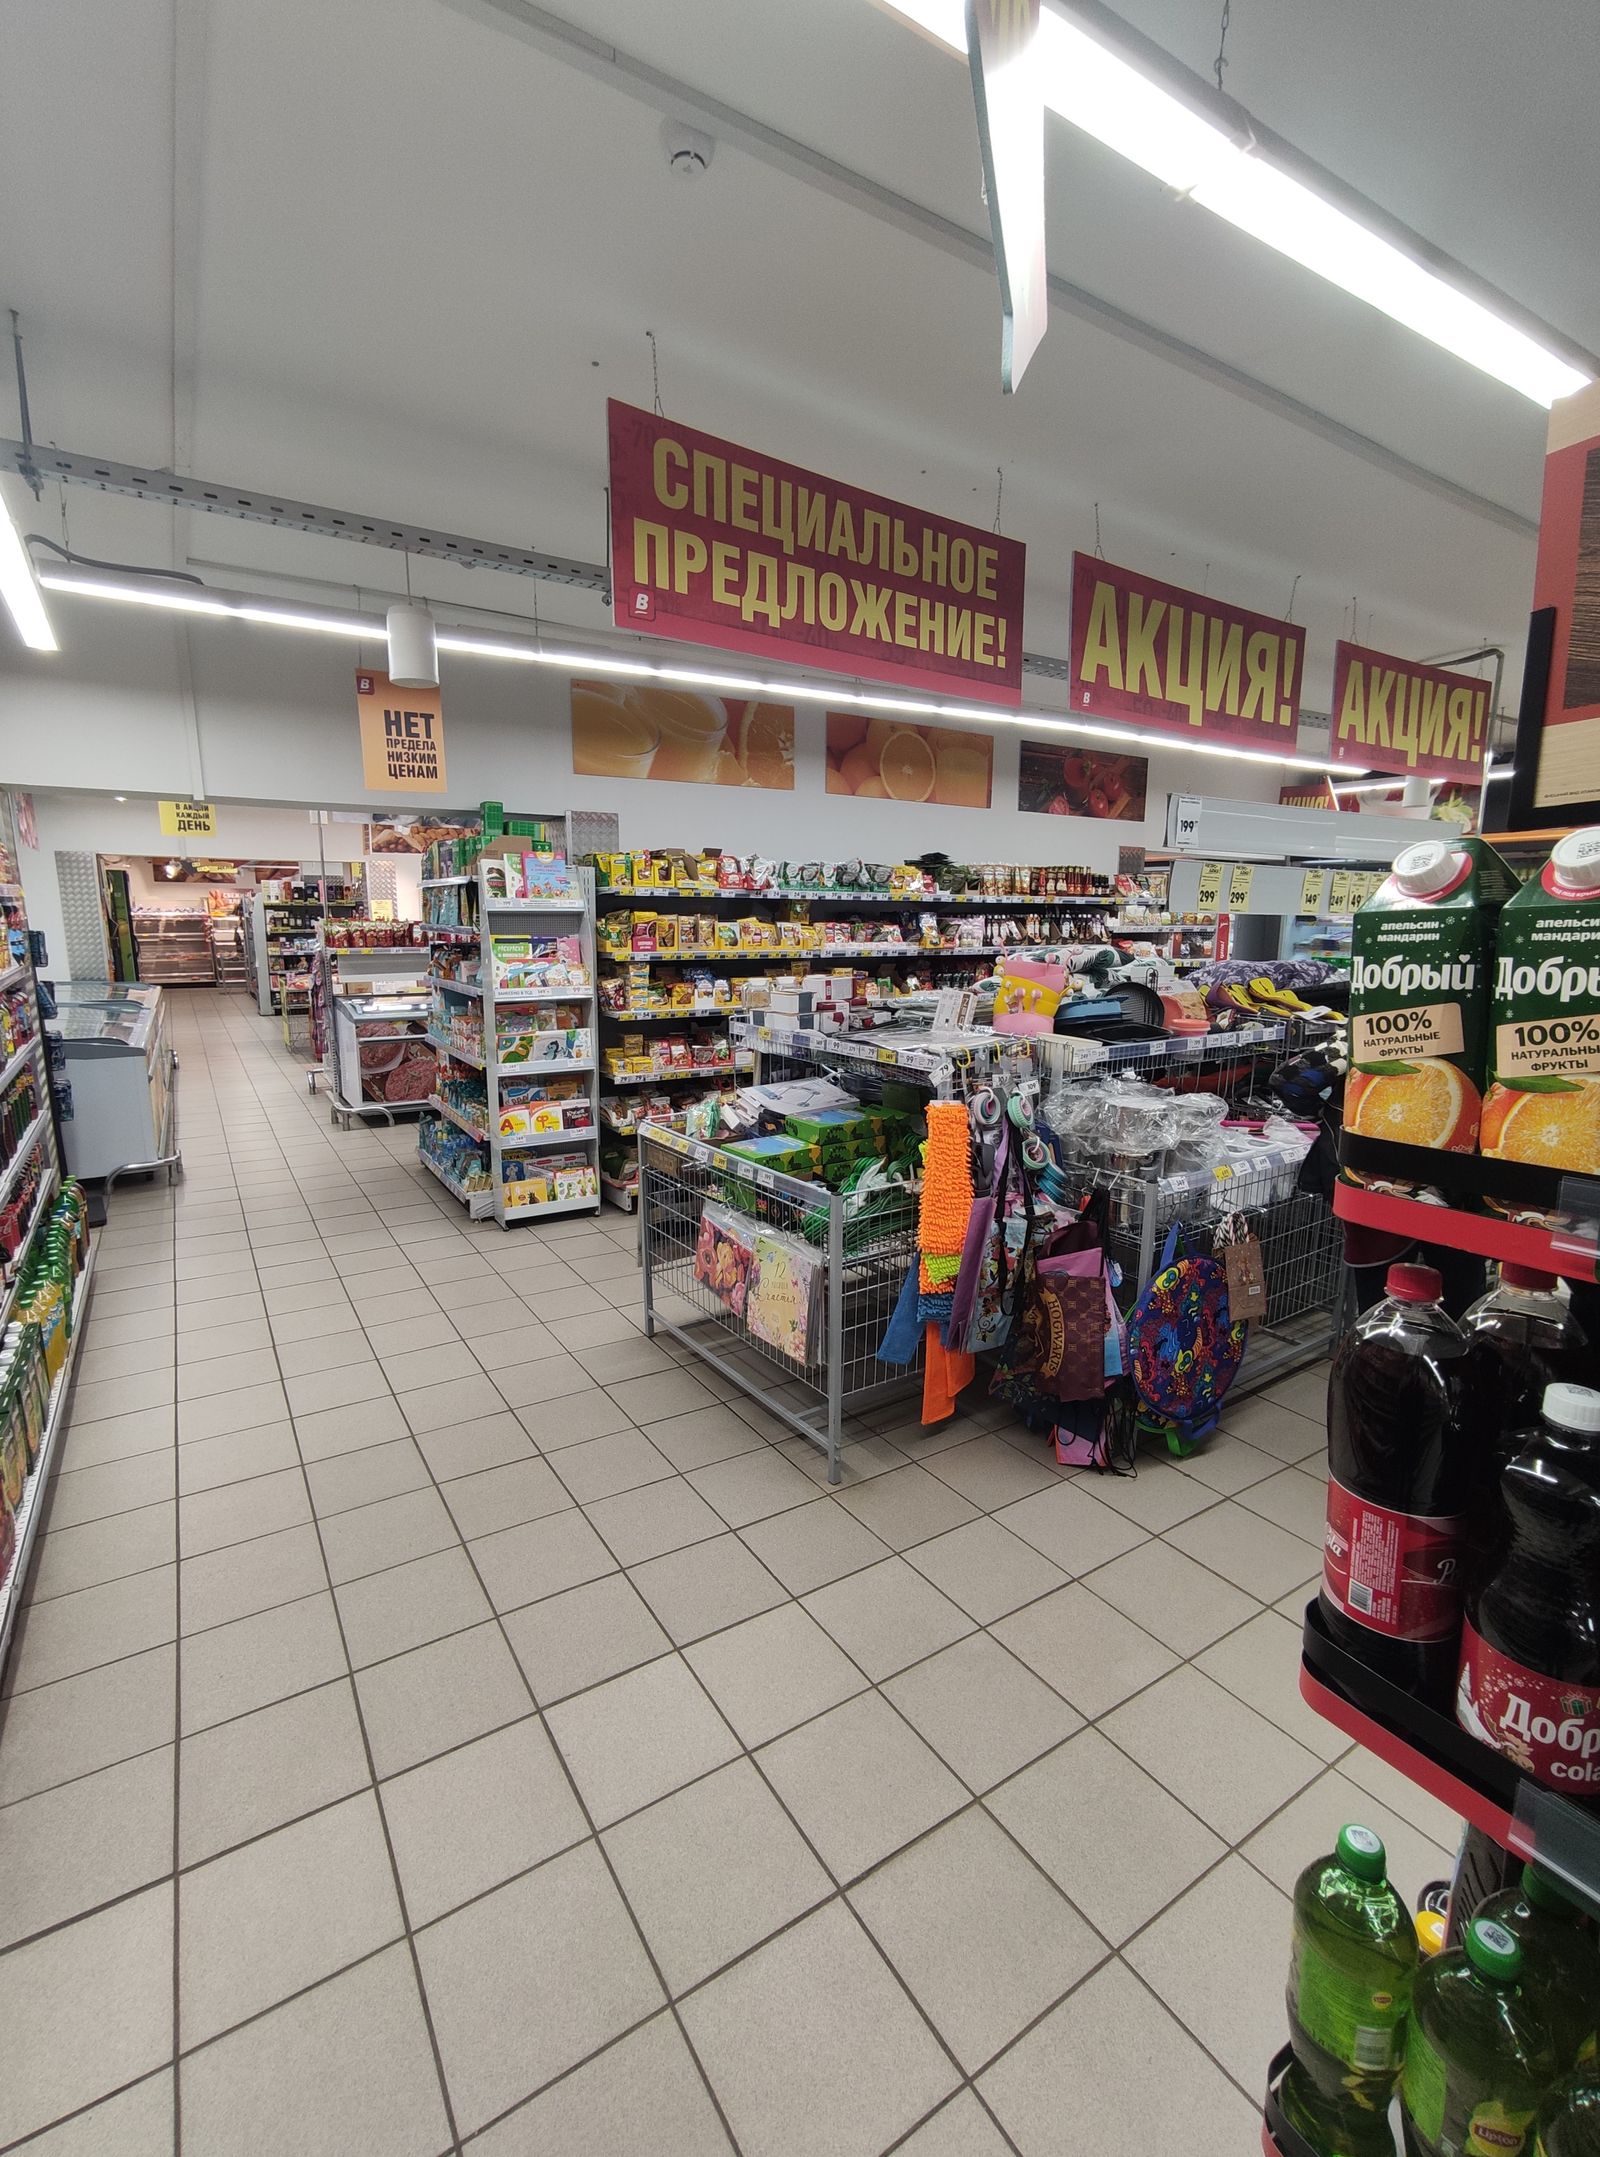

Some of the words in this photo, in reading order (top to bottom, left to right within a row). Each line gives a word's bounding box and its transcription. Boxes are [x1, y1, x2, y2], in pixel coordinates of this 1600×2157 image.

[652, 438, 999, 601] СПЕЦИАЛЬНОЕ
[633, 517, 1007, 669] ПРЕДЛОЖЕНИЕ!
[1079, 580, 1297, 727] АКЦИЯ!
[1338, 660, 1486, 767] АКЦИЯ!
[384, 710, 434, 739] НЕТ
[386, 738, 437, 752] ПРЕДЕЛА
[387, 751, 437, 765] НИЗКИМ
[388, 764, 438, 780] ЦЕНАМ
[176, 812, 209, 820] КАЖДЫЙ
[177, 820, 211, 832] ДЕНЬ
[1380, 921, 1440, 931] апельсин
[1535, 918, 1600, 928] апельси
[1377, 932, 1440, 943] мандарин
[1531, 930, 1600, 942] мандари
[1351, 954, 1476, 996] Добрый
[1366, 1009, 1432, 1036] 100%
[1363, 1031, 1440, 1048] НАТУРАЛЬНЫЕ
[1514, 1018, 1600, 1047] 100%
[1379, 1045, 1424, 1057] ФРУКТЫ
[1531, 1058, 1589, 1072] ФРУКТЫ
[1048, 1300, 1063, 1374] HOGWARTS
[1499, 1692, 1600, 1759] Добр
